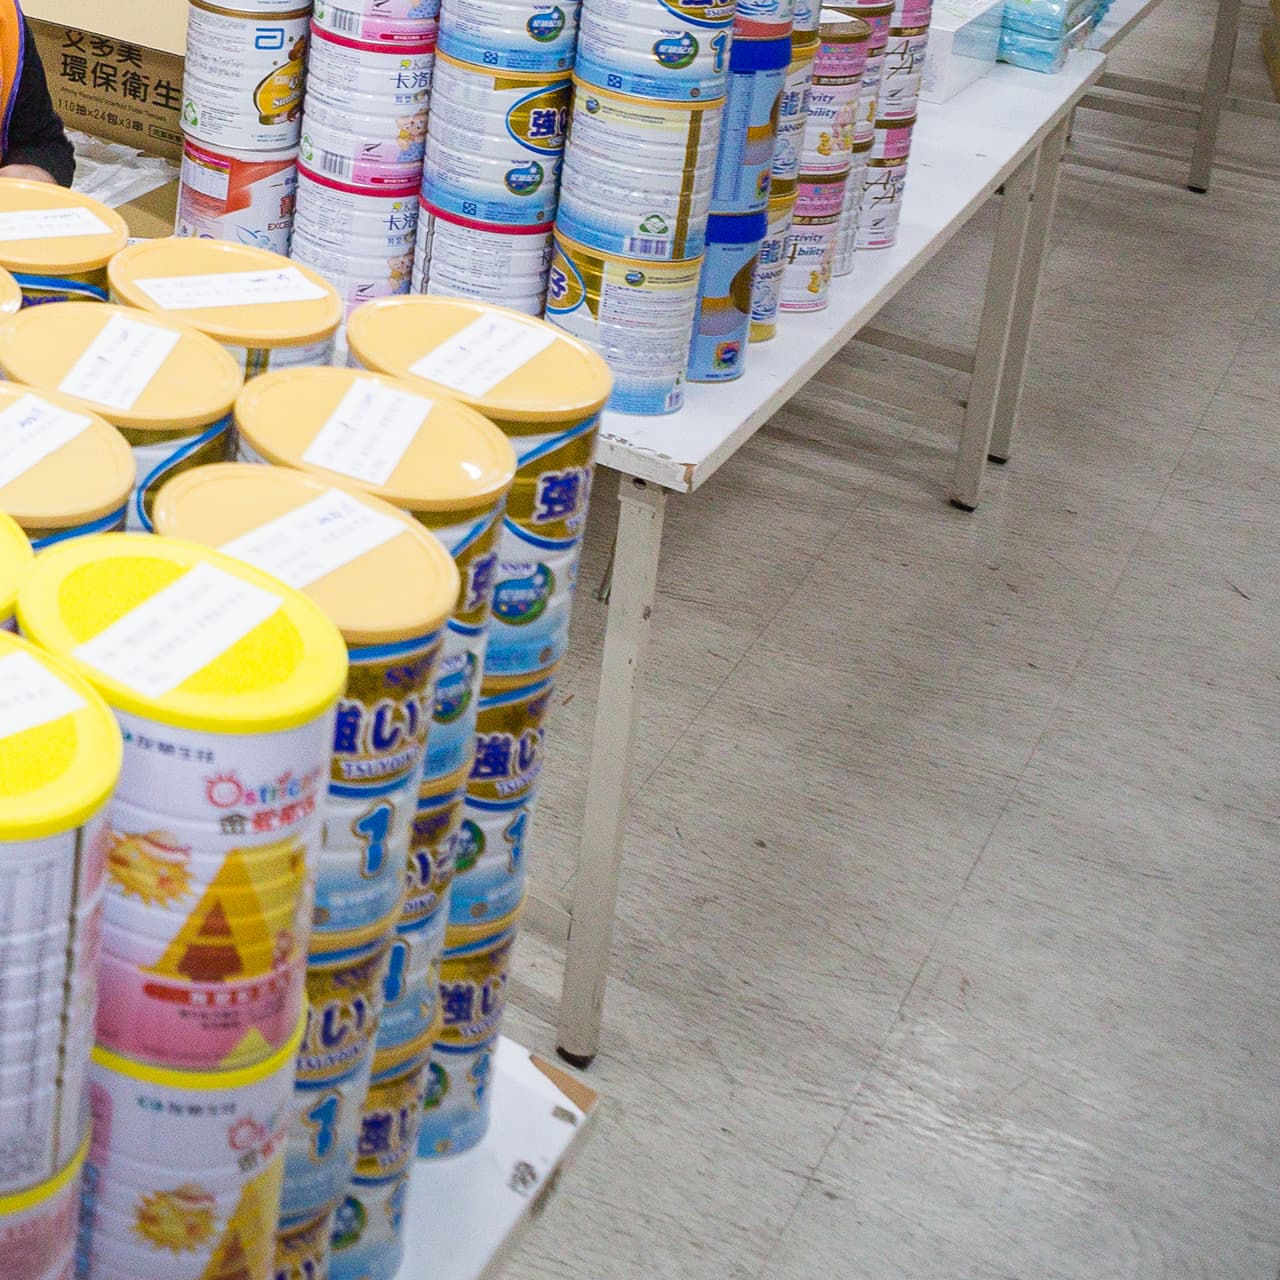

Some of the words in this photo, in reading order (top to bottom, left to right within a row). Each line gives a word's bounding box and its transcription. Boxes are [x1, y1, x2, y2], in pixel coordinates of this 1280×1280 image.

[710, 30, 728, 73] 1
[60, 53, 183, 111] 環保衛生
[356, 801, 393, 877] 1
